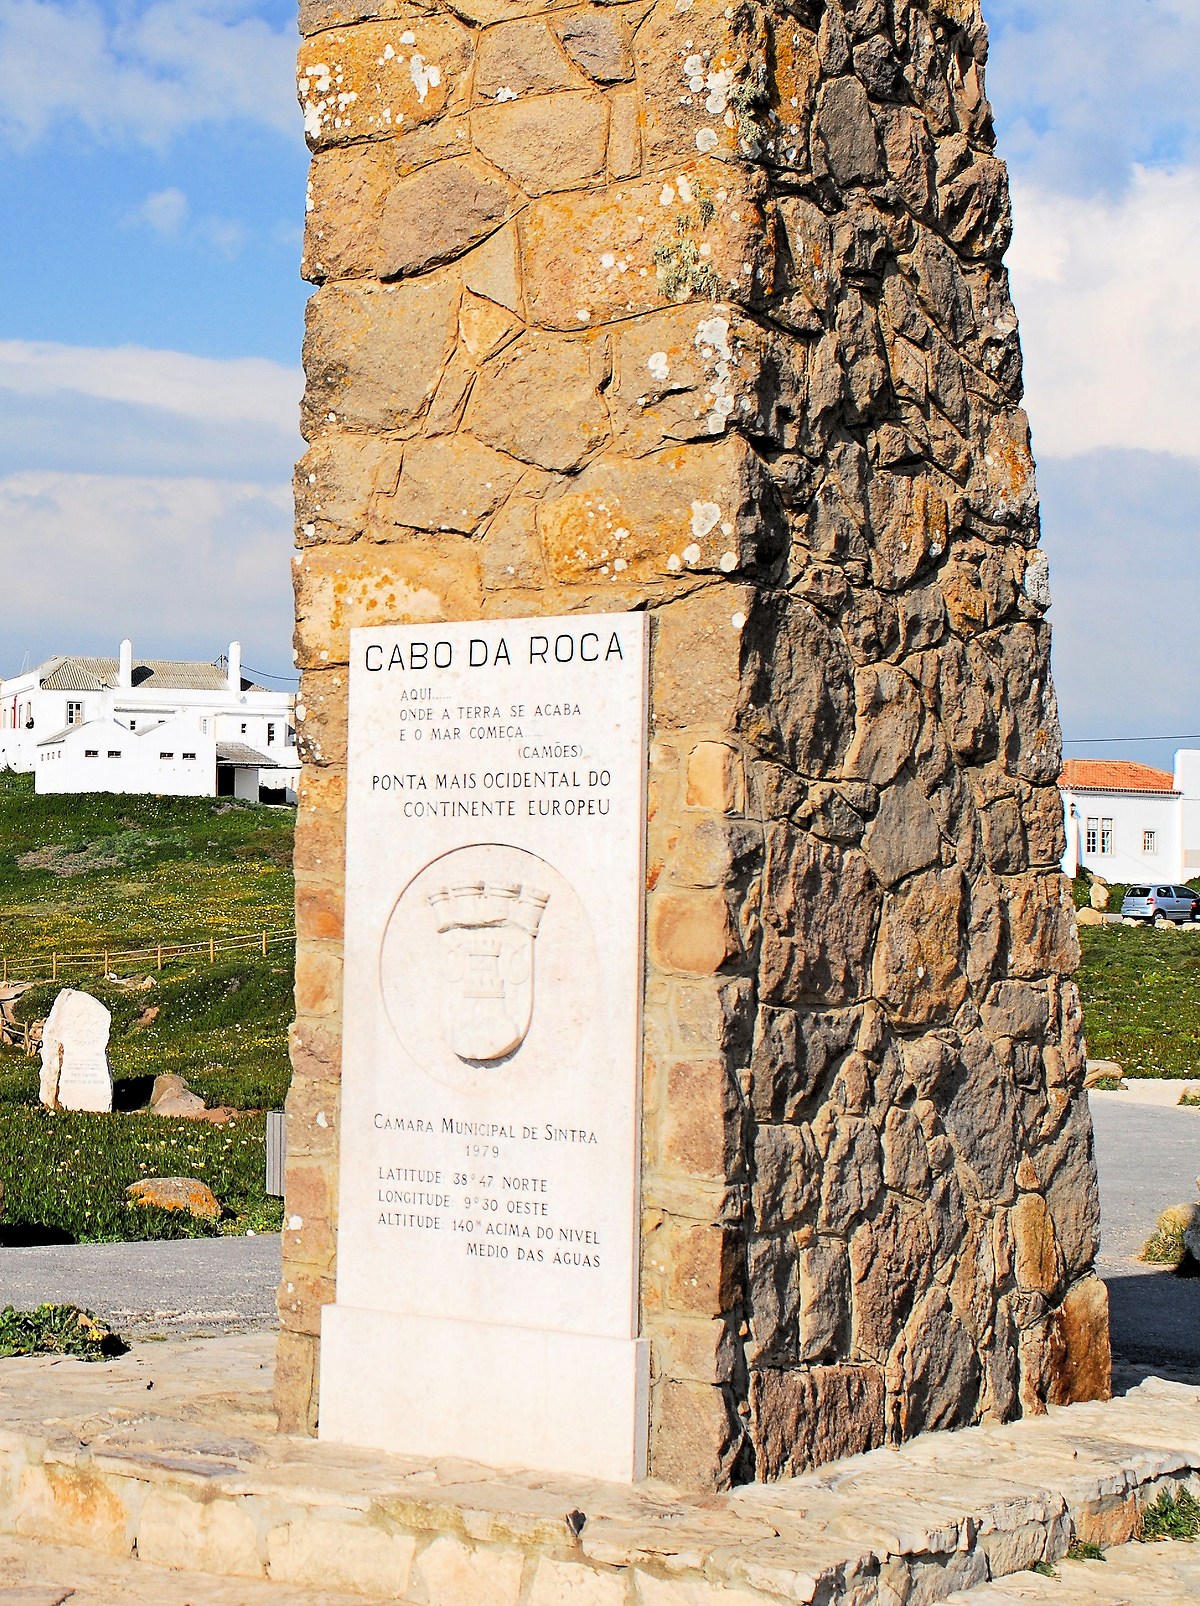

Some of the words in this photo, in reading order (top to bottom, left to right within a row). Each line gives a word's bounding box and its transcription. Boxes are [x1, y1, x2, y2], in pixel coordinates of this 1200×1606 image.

[365, 640, 454, 672] CABO
[468, 637, 512, 668] DA
[529, 631, 624, 664] ROCA
[399, 707, 434, 722] ONDE
[441, 707, 451, 721] A
[457, 705, 502, 720] TERRA
[510, 704, 525, 718] SE
[534, 703, 582, 717] ACABA
[400, 729, 406, 742] E
[414, 728, 423, 741] O
[431, 727, 461, 741] MAR
[372, 774, 427, 792] PONTA
[435, 772, 477, 790] MAIS
[483, 770, 581, 789] OCIDENTAL
[588, 770, 612, 787] DO
[403, 801, 516, 818] CONTINENTE
[528, 799, 610, 816] EUROPEU
[465, 1144, 500, 1158] 1979
[502, 1176, 548, 1193] NORTE
[506, 1201, 549, 1216] OESTE
[486, 1223, 531, 1239] ACIMA
[537, 1226, 554, 1240] DO
[559, 1228, 600, 1245] NIVEL
[466, 1242, 509, 1259] MEDIO
[517, 1248, 544, 1262] DAS
